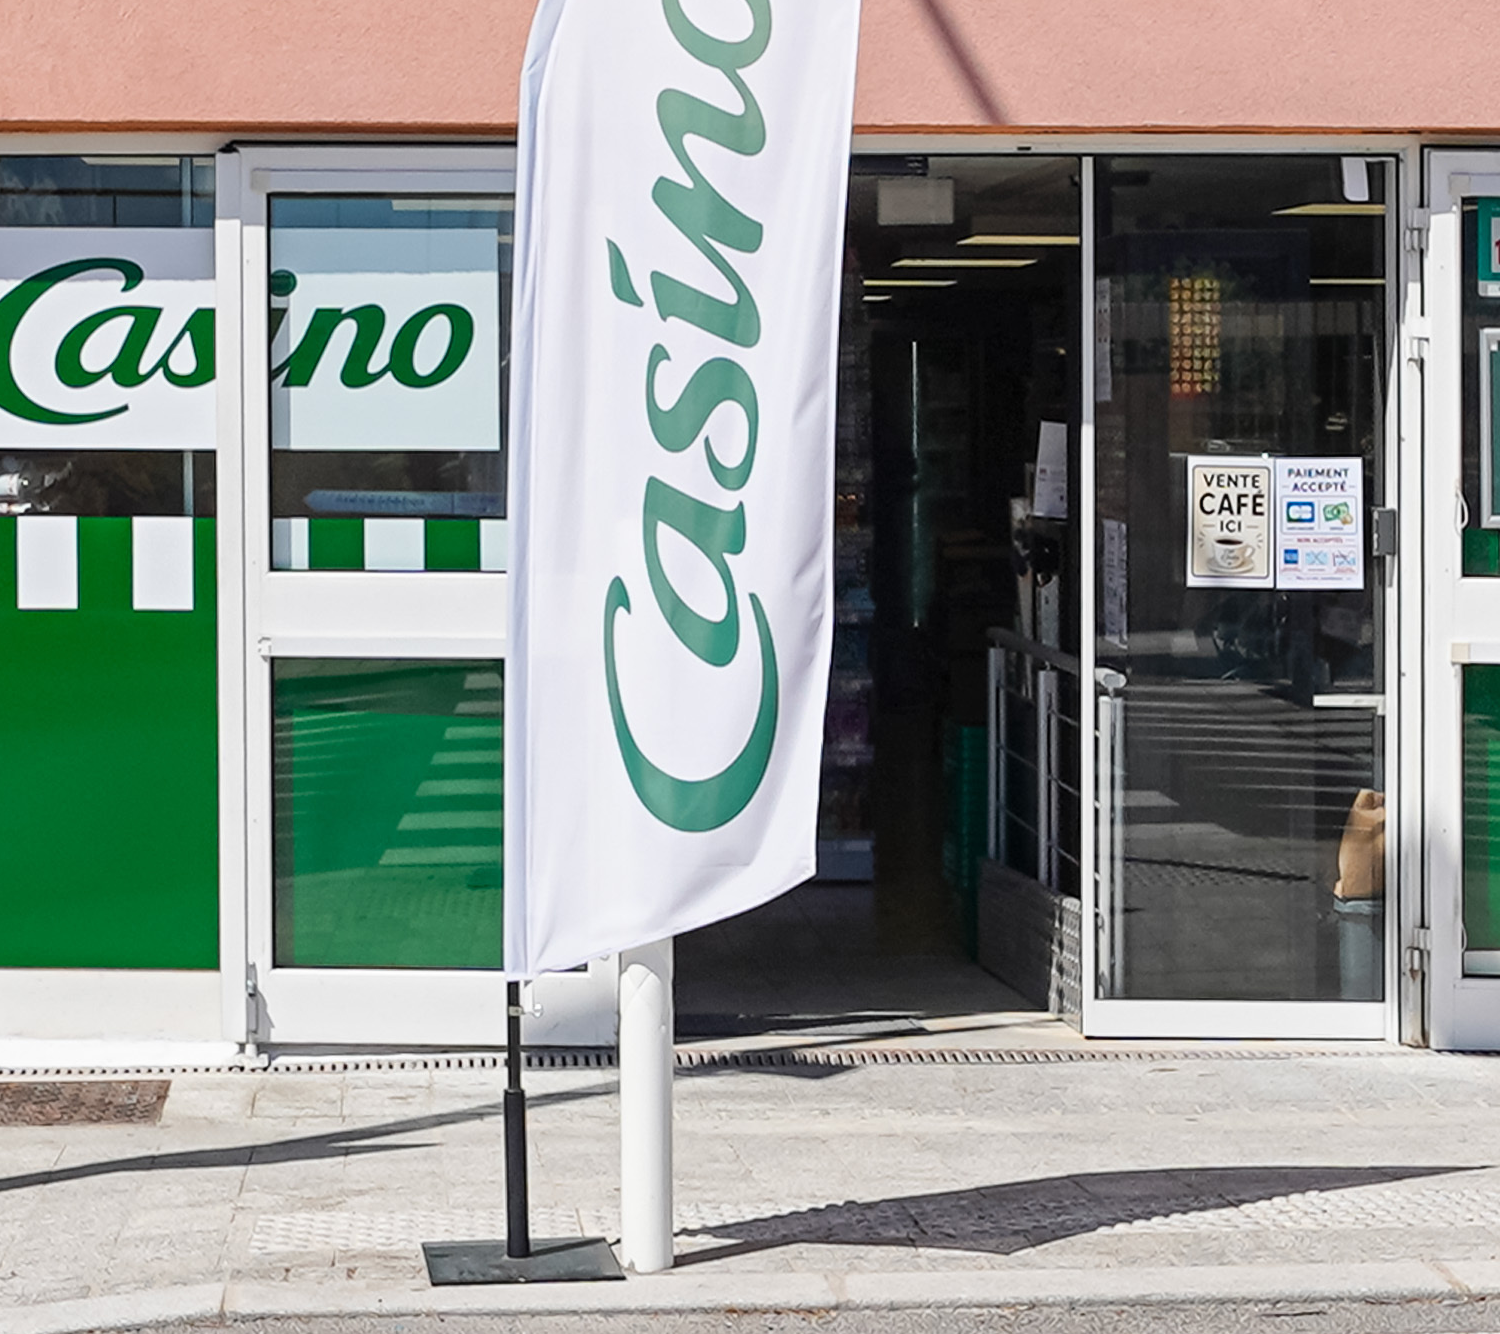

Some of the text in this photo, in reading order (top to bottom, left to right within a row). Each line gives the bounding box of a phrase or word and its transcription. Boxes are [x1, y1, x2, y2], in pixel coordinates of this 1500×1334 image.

[1287, 468, 1350, 479] PAIEMENT
[1203, 473, 1260, 488] VENTE
[1291, 481, 1347, 492] ACCEPTÉ
[1199, 490, 1265, 516] CAFÉ
[1220, 520, 1242, 533] ICI
